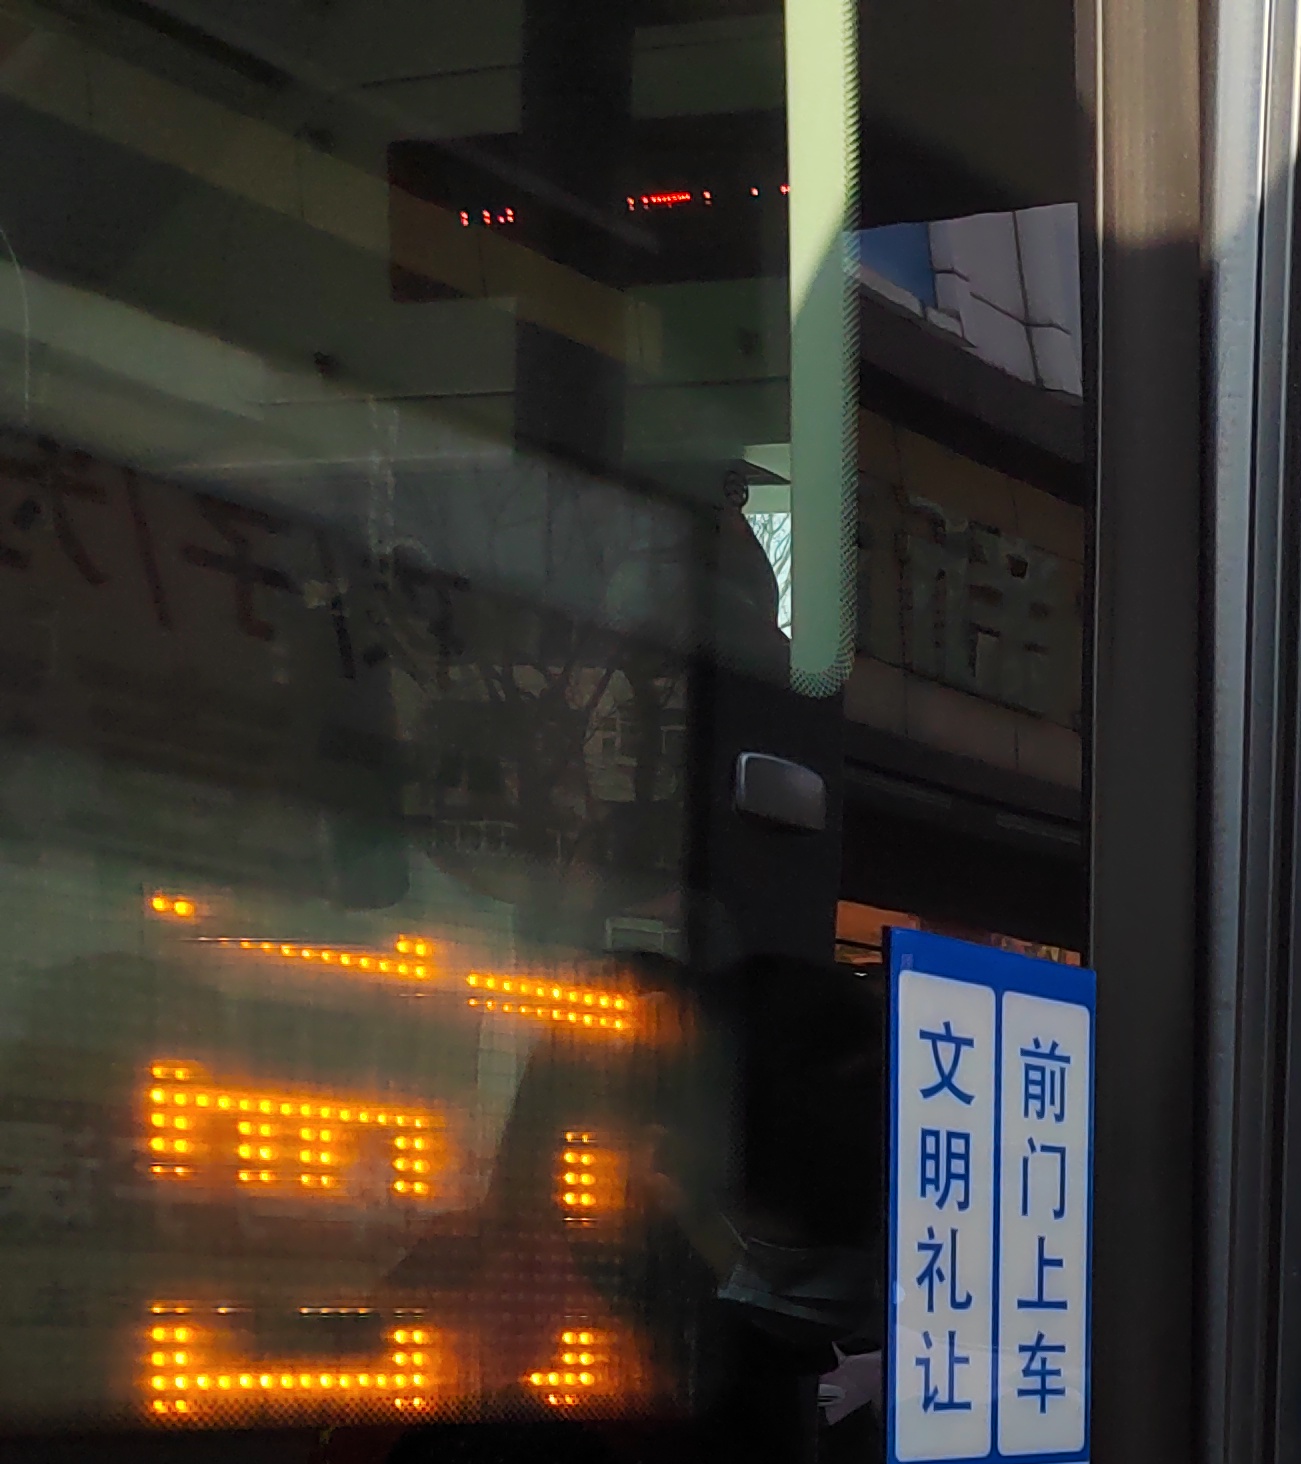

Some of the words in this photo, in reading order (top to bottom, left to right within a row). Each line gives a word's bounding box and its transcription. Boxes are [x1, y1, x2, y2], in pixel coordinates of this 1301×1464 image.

[915, 1021, 976, 1413] 文明礼让
[1017, 1038, 1072, 1414] 前门上车
